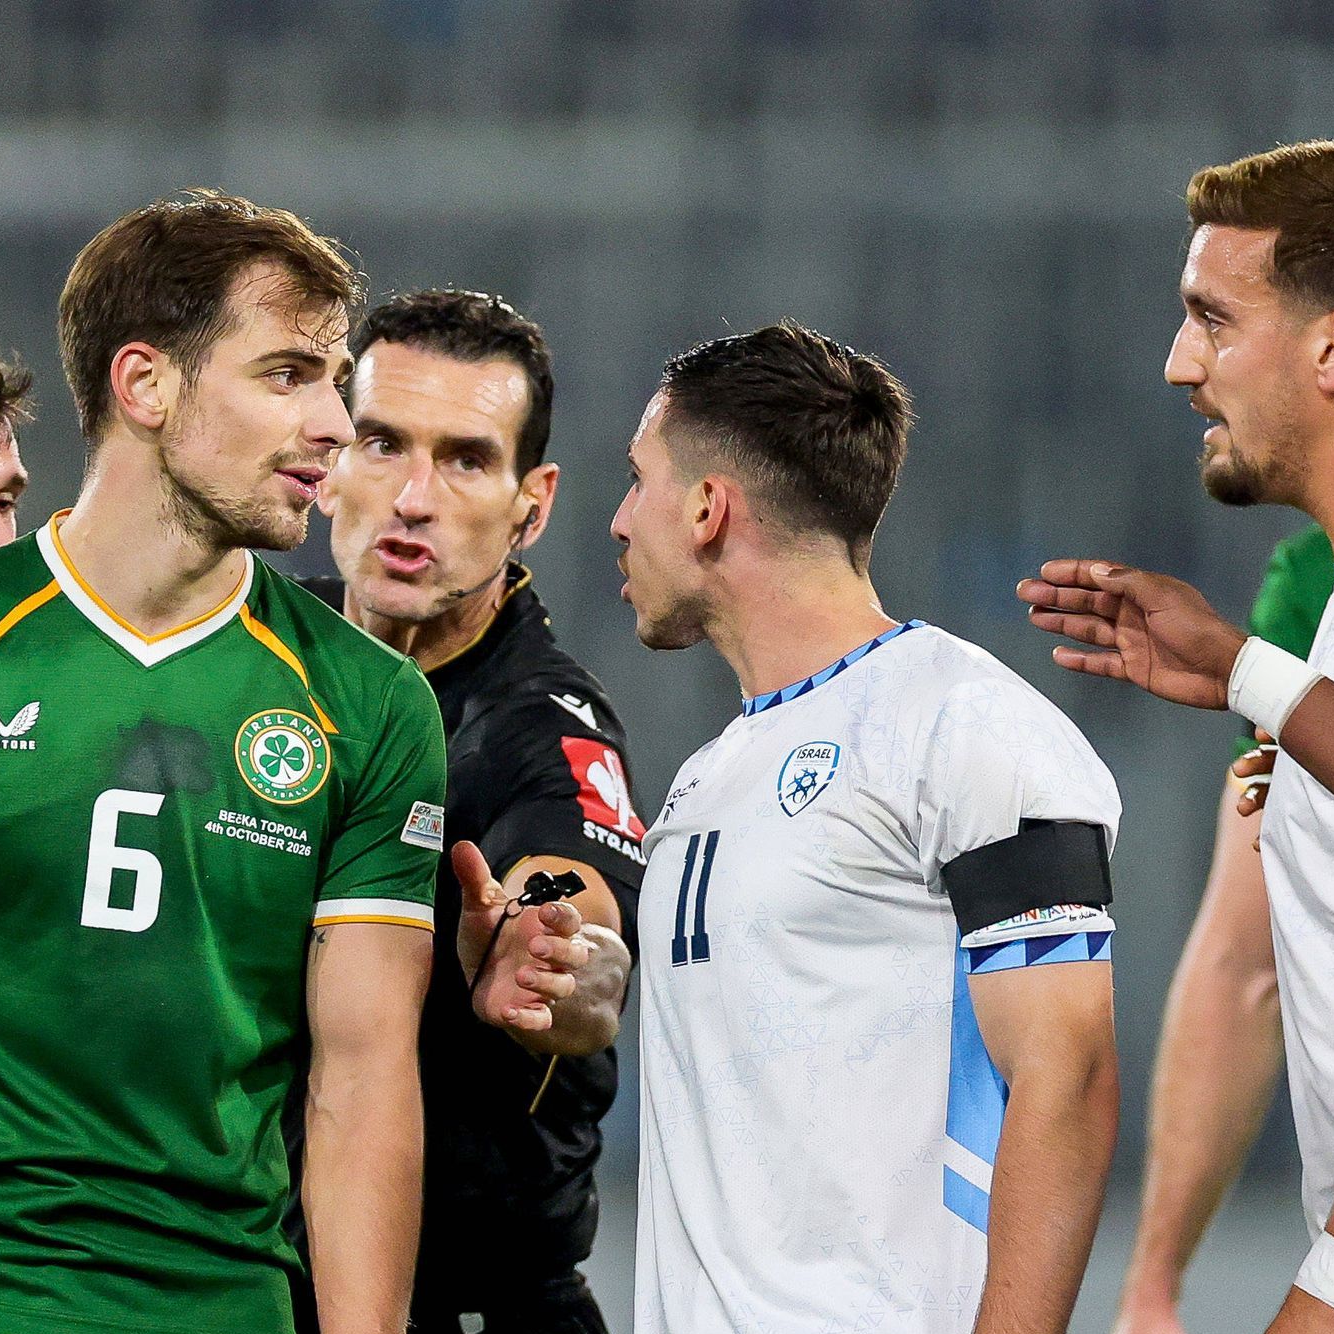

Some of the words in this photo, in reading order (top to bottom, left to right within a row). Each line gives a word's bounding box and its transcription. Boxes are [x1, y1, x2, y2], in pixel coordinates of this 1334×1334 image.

[244, 714, 323, 748] IRELAND
[797, 748, 832, 760] ISRAEL
[251, 776, 308, 798] FOOTBALL
[204, 821, 224, 836] 4th
[226, 826, 285, 851] OCTOBER
[286, 842, 312, 857] 2026
[260, 819, 308, 842] TOPOLA
[80, 788, 166, 933] 6
[671, 829, 721, 967] 11
